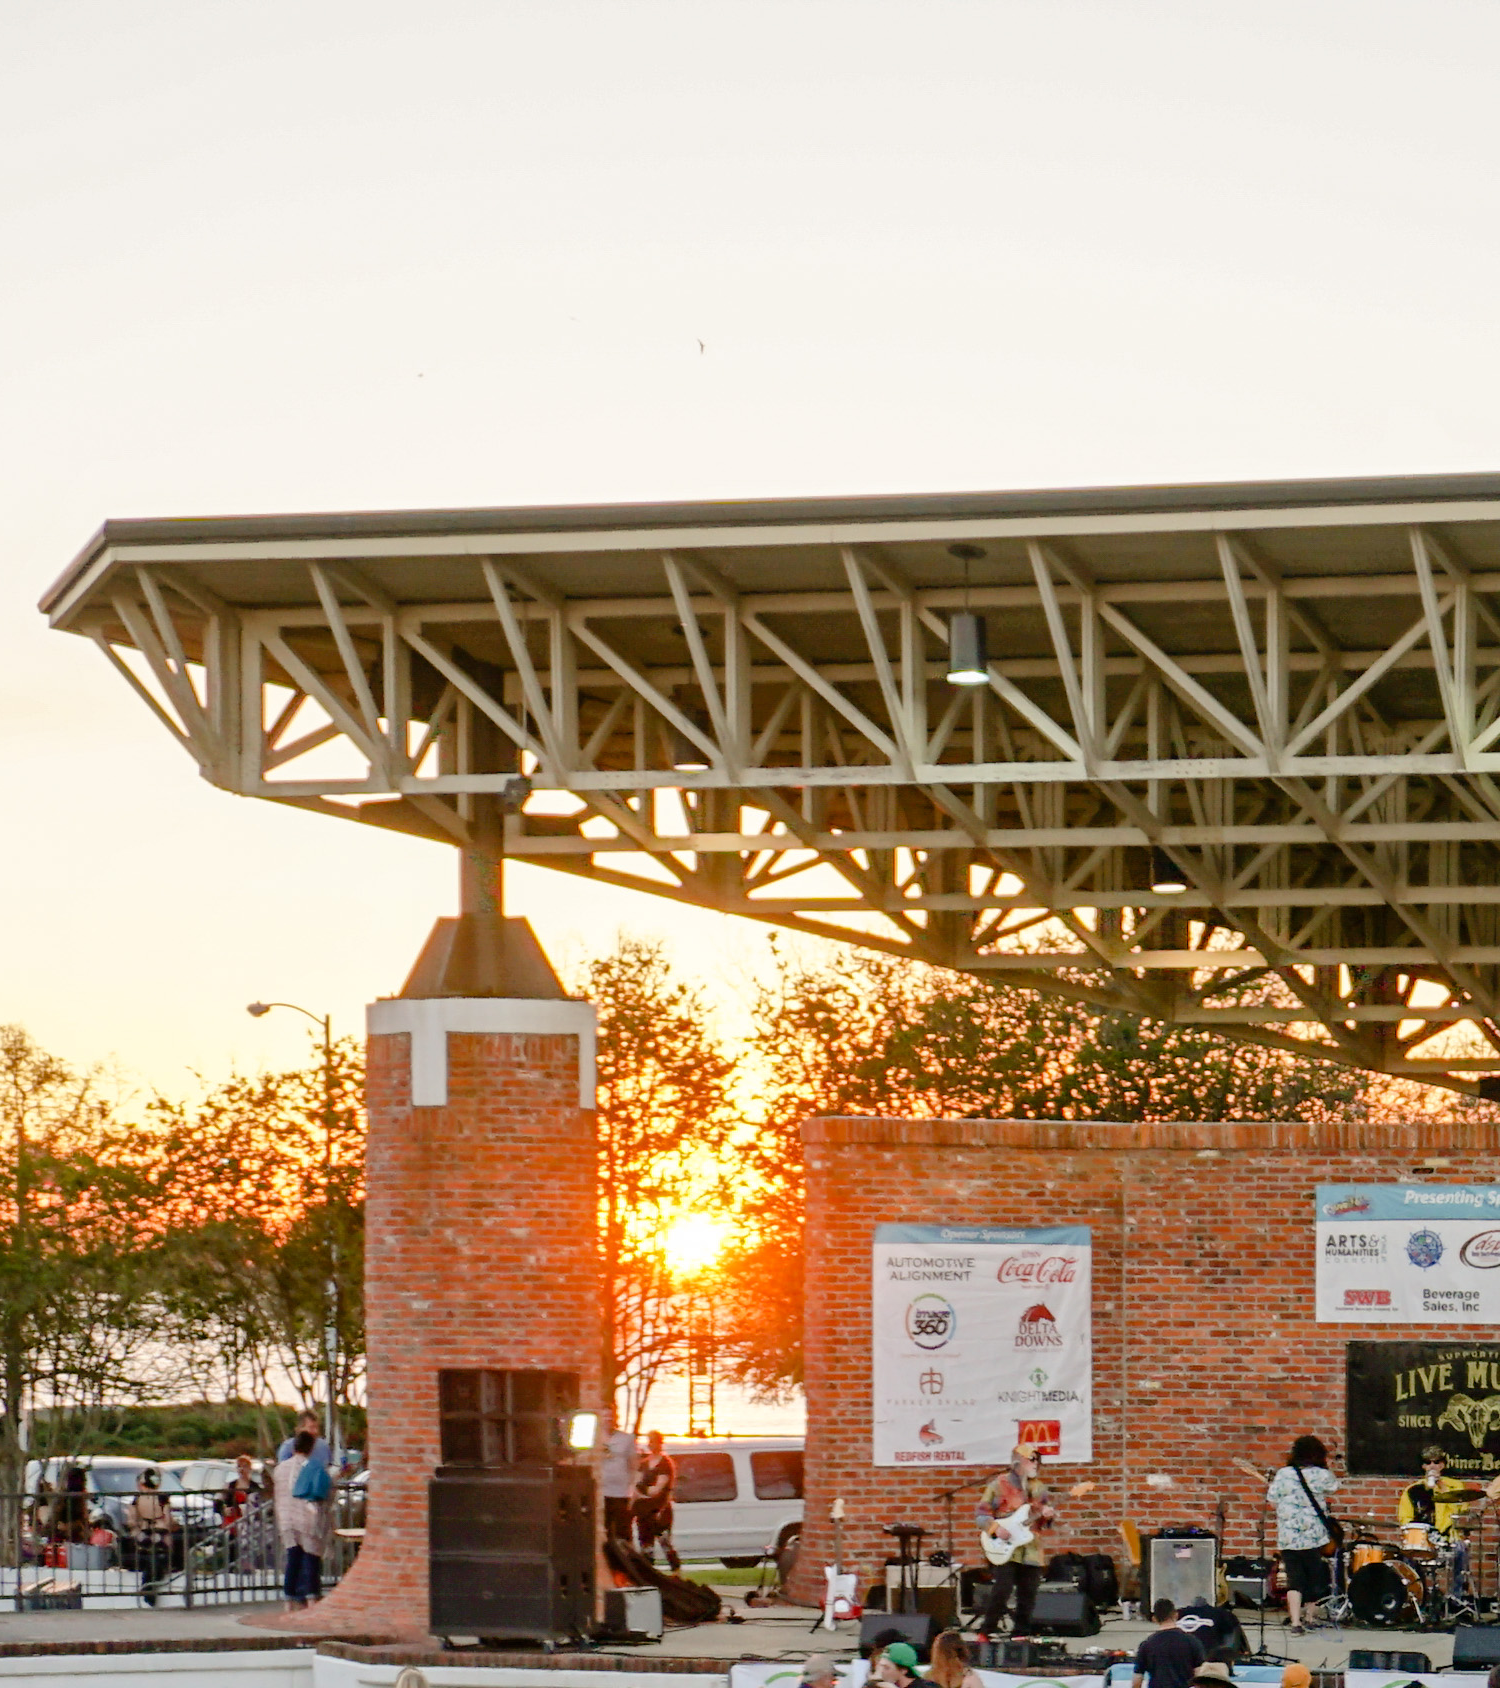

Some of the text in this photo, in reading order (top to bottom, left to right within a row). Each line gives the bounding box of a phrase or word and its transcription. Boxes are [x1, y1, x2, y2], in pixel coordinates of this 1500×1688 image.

[1404, 1190, 1484, 1207] Presenting
[1327, 1235, 1380, 1248] ARTS &
[1325, 1248, 1380, 1257] HUMANITIES
[886, 1256, 975, 1268] AUTOMOTIVE
[889, 1271, 973, 1282] ALIGNMENT
[1344, 1289, 1392, 1306] SWB
[1423, 1289, 1480, 1301] Beverage
[1423, 1301, 1480, 1312] Sales, Inc
[916, 1309, 950, 1322] image
[912, 1320, 949, 1336] 360
[1018, 1322, 1058, 1335] DELTA
[1014, 1335, 1063, 1347] DOWNS
[1394, 1362, 1455, 1402] LIVE
[998, 1390, 1080, 1404] KNIGHTMEDIA
[1398, 1415, 1432, 1428] SINCE
[894, 1451, 967, 1462] REDFISH RENTAL
[1443, 1453, 1481, 1470] hiner
